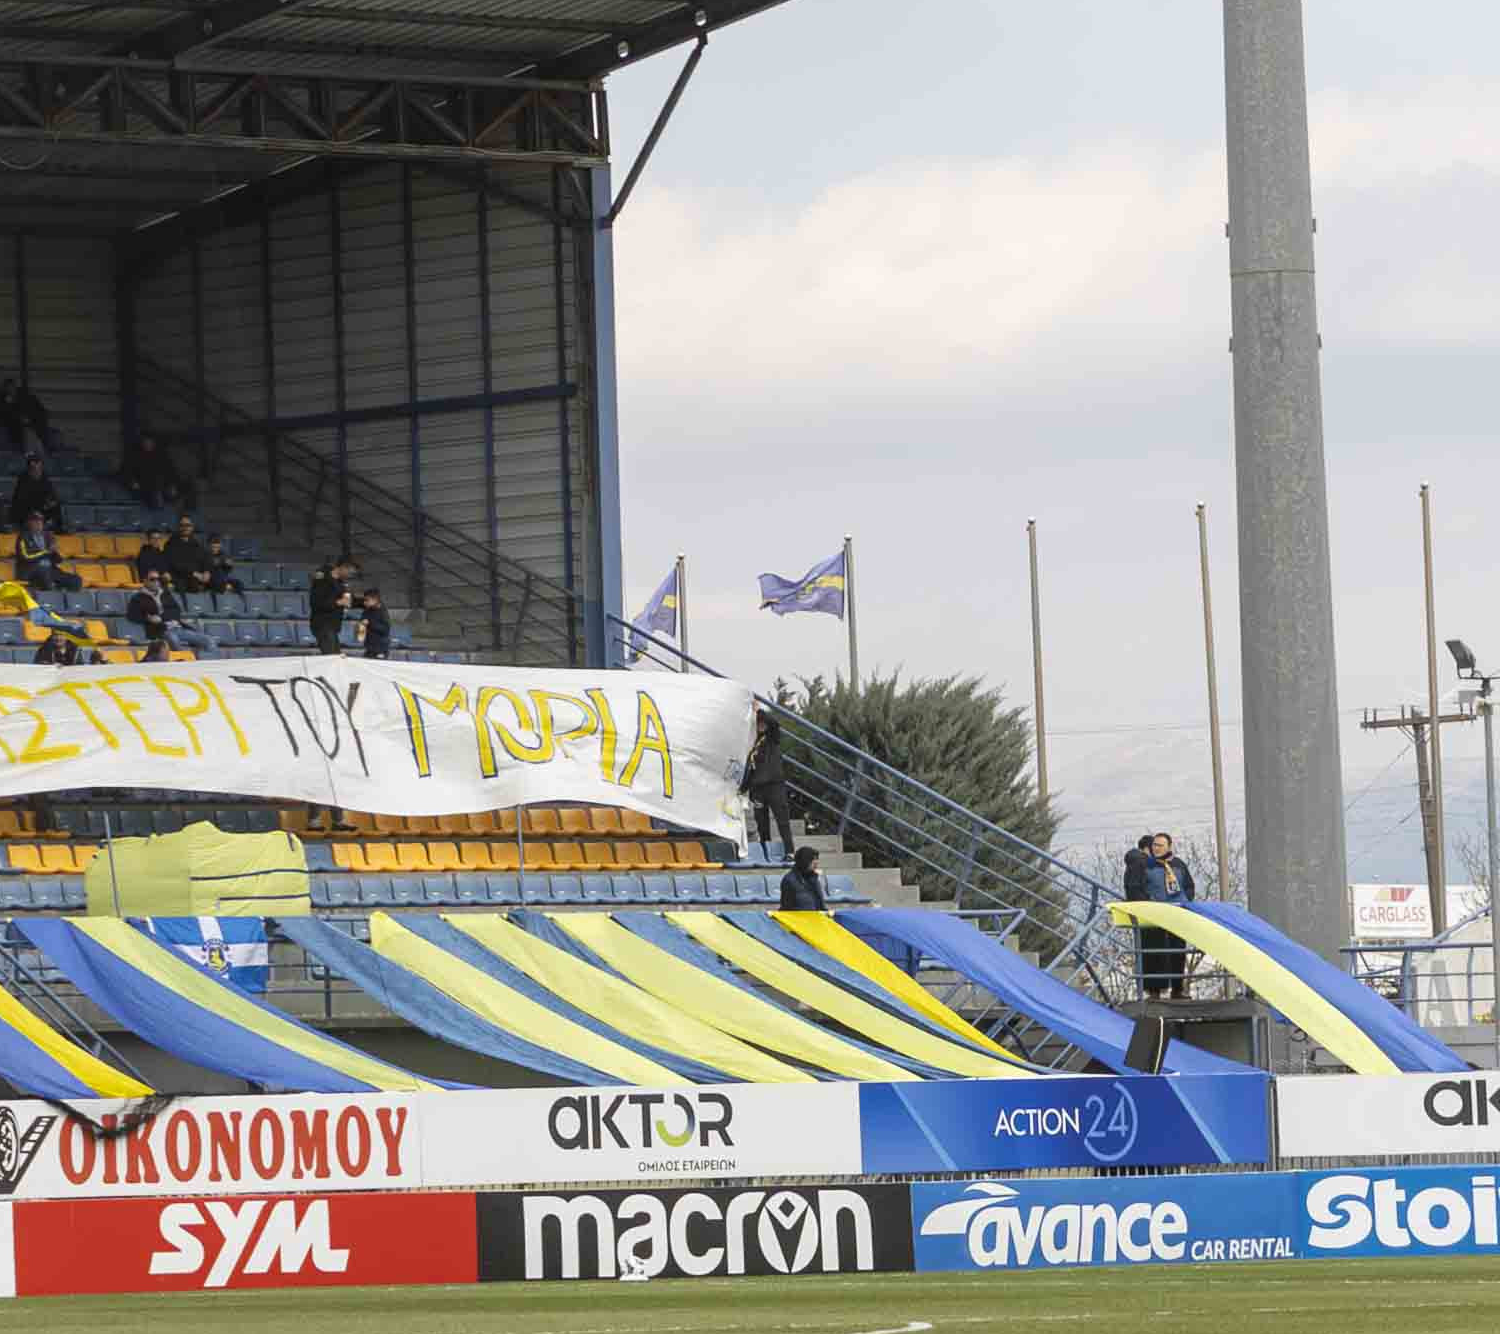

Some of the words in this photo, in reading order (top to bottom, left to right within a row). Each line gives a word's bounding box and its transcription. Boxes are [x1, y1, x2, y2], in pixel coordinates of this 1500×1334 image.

[229, 674, 370, 778] ΤΟΥ
[393, 680, 674, 798] ΜΟΡΙΑ
[1359, 906, 1427, 923] CARGLASS
[58, 1105, 407, 1186] ΟΙΚΟΝΟΜΟΥ
[994, 1107, 1080, 1137] ACTION
[1083, 1094, 1130, 1137] 24
[638, 1161, 680, 1172] ΟΜΙΛΟΣ
[148, 1199, 350, 1288] SYM
[522, 1190, 875, 1280] macron
[966, 1197, 1189, 1268] avance
[1191, 1241, 1226, 1260] CAR
[1228, 1238, 1294, 1259] RENTAL
